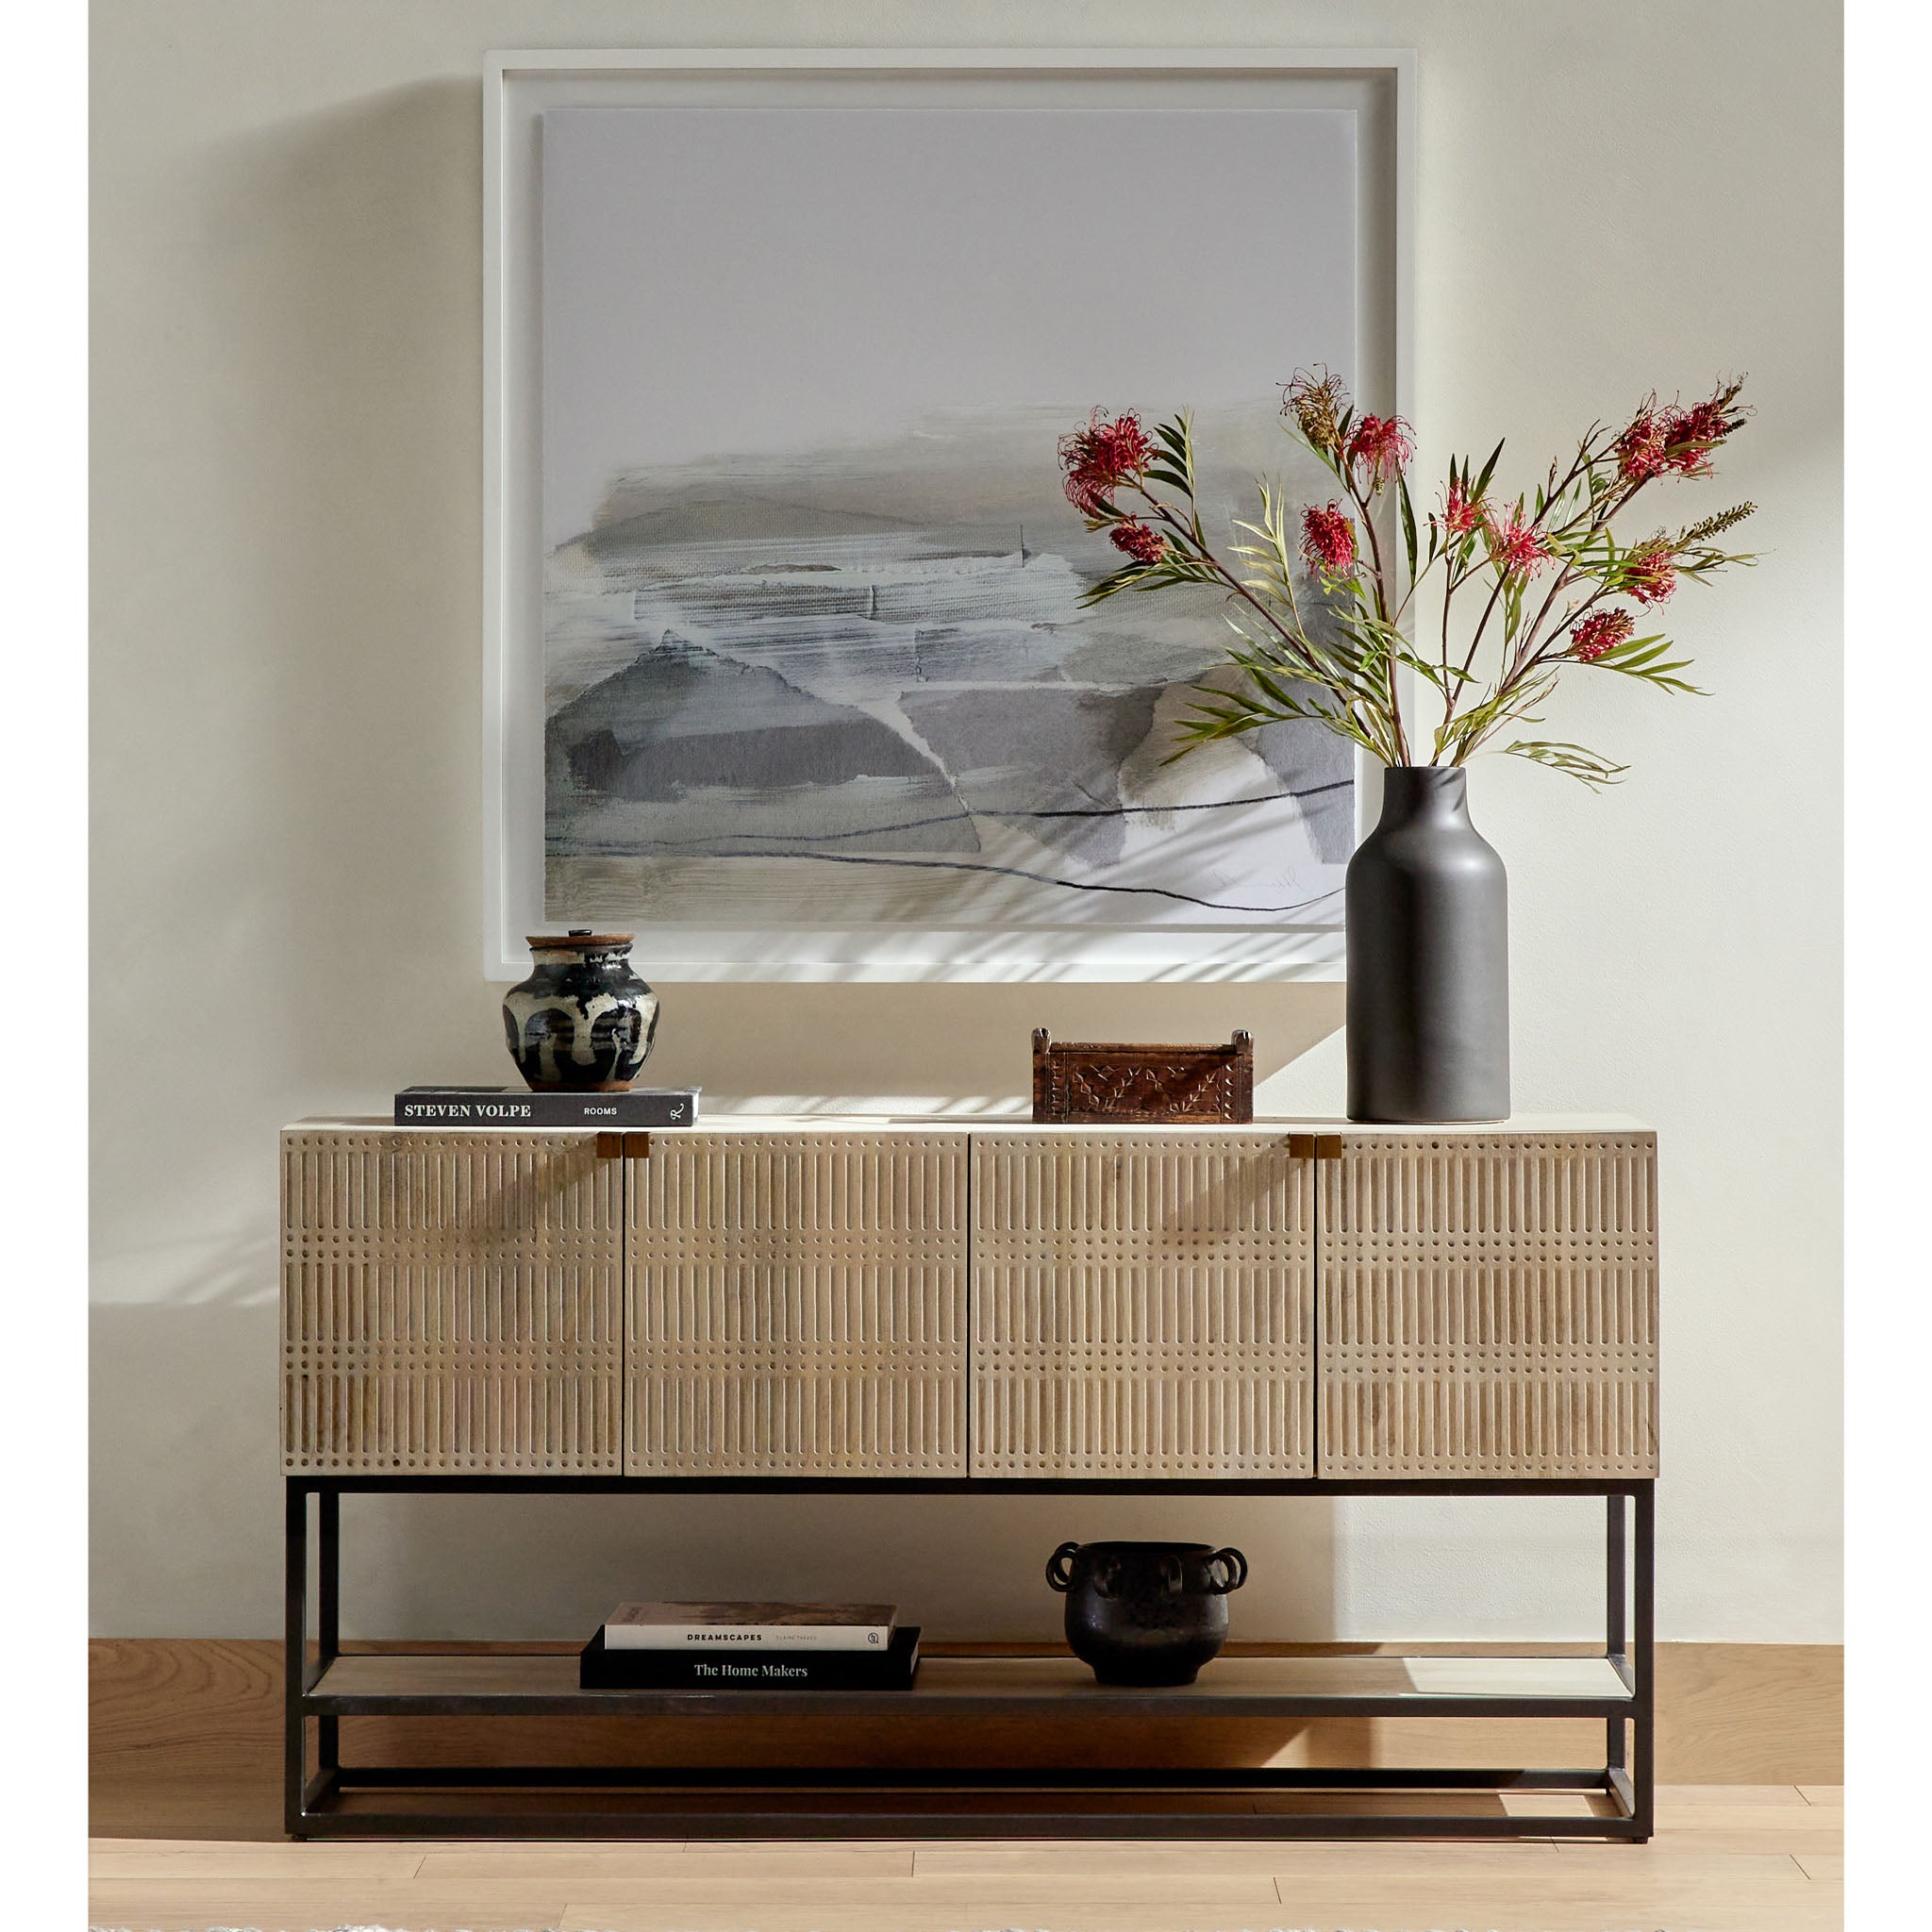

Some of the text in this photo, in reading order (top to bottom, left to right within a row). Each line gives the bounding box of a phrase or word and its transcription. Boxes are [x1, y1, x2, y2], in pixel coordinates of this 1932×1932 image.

[404, 1104, 531, 1117] STEVEN VOLPE
[583, 1107, 618, 1116] ROOMS
[693, 1664, 808, 1677] The Home Makers
